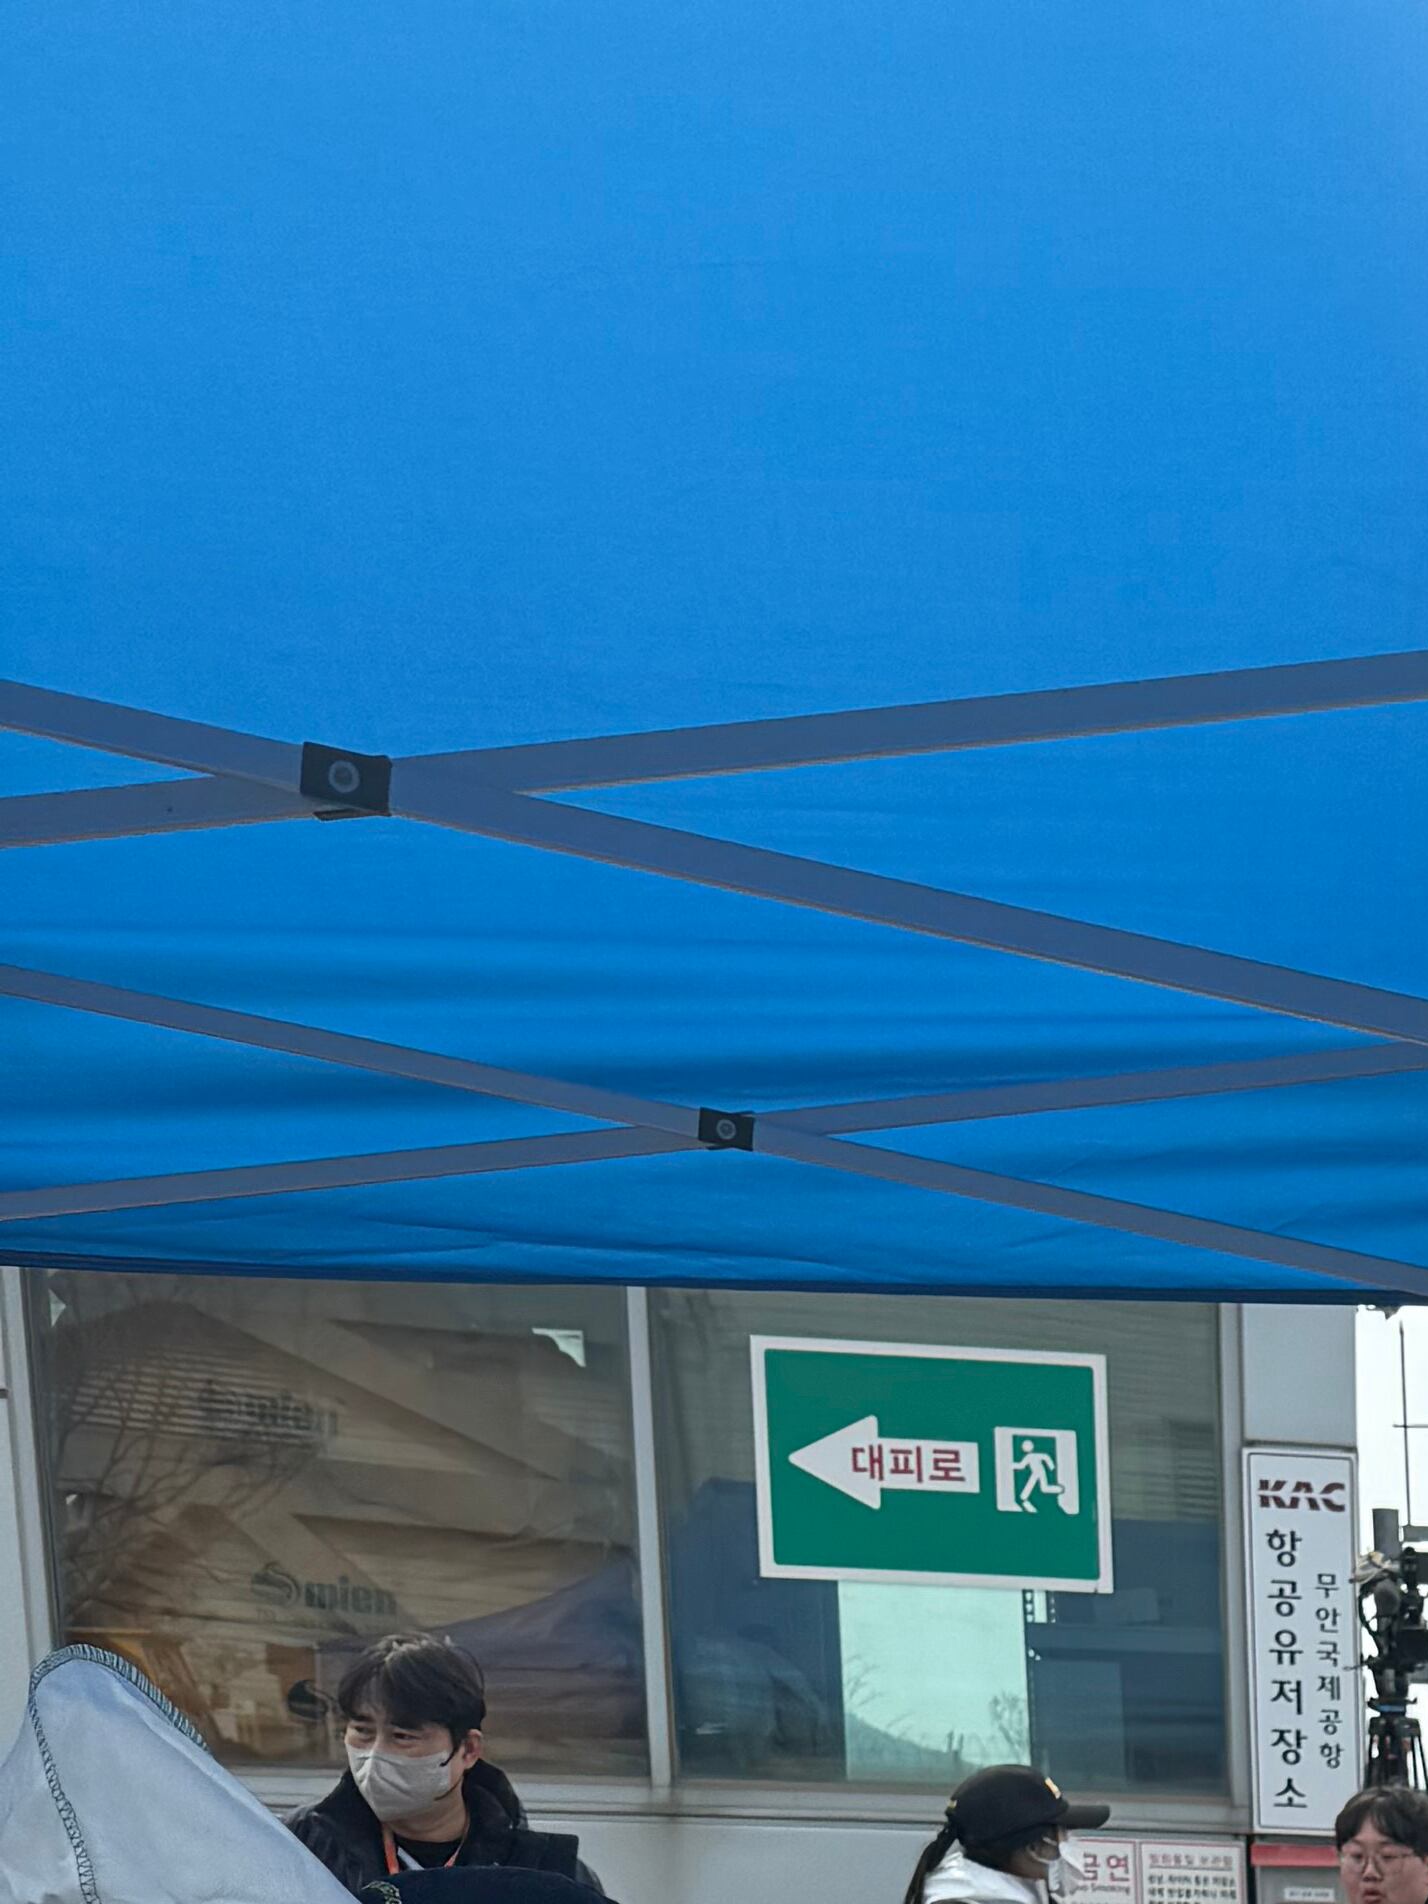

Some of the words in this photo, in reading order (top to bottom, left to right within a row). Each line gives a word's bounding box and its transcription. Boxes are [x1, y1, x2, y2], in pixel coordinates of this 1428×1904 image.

[852, 1444, 967, 1485] 대피로
[1257, 1478, 1347, 1513] KAC
[1265, 1527, 1309, 1811] 항공유저장소
[1313, 1572, 1346, 1770] 무안국제공항
[1083, 1852, 1130, 1882] 금연
